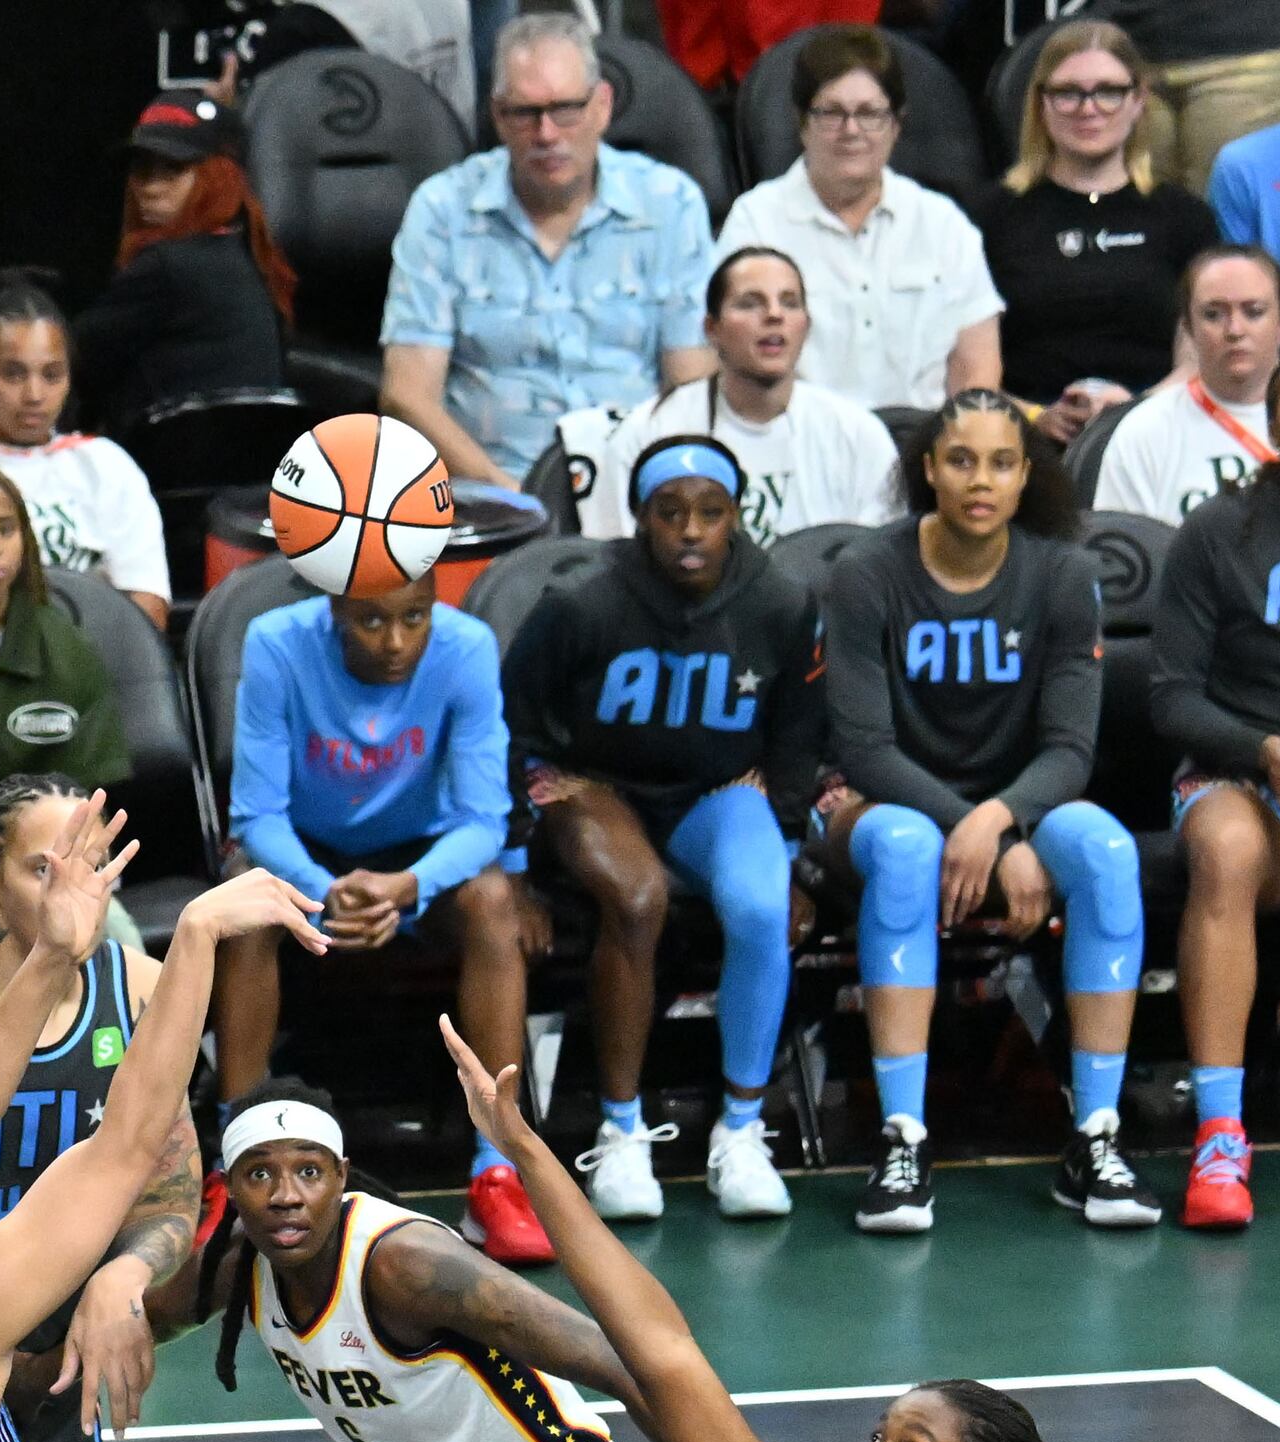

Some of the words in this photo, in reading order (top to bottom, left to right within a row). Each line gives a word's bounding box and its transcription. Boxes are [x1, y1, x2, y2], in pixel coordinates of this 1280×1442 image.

[907, 618, 1022, 683] ATL
[595, 647, 758, 732] ATL
[272, 1347, 400, 1409] FEVER
